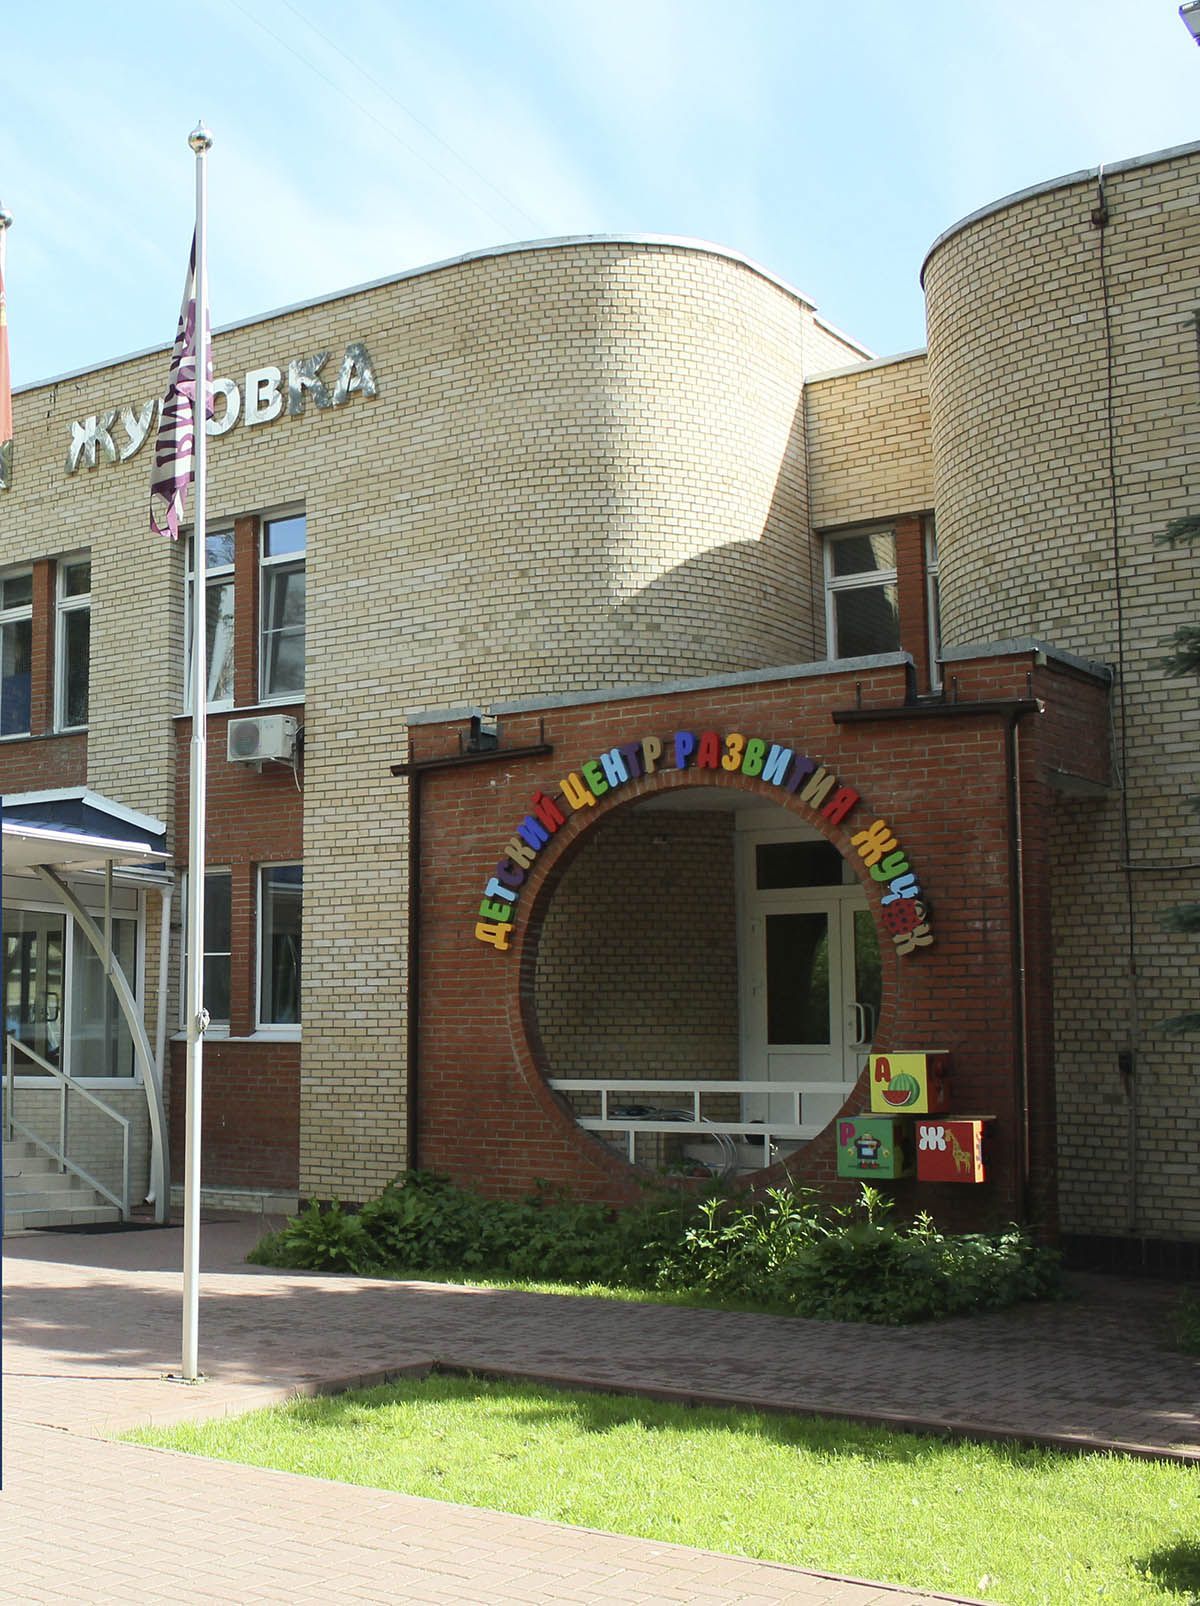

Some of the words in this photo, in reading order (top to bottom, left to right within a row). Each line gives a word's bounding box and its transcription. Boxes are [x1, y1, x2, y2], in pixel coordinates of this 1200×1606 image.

[64, 342, 380, 474] ЖУОВКА
[474, 790, 567, 951] ДЕТСКИЙ
[559, 735, 663, 810] ЦЕНТР
[674, 730, 861, 825] РАЗВИТИЯ
[874, 1056, 892, 1083] А
[839, 1121, 856, 1148] Р
[918, 1125, 947, 1151] Ж
